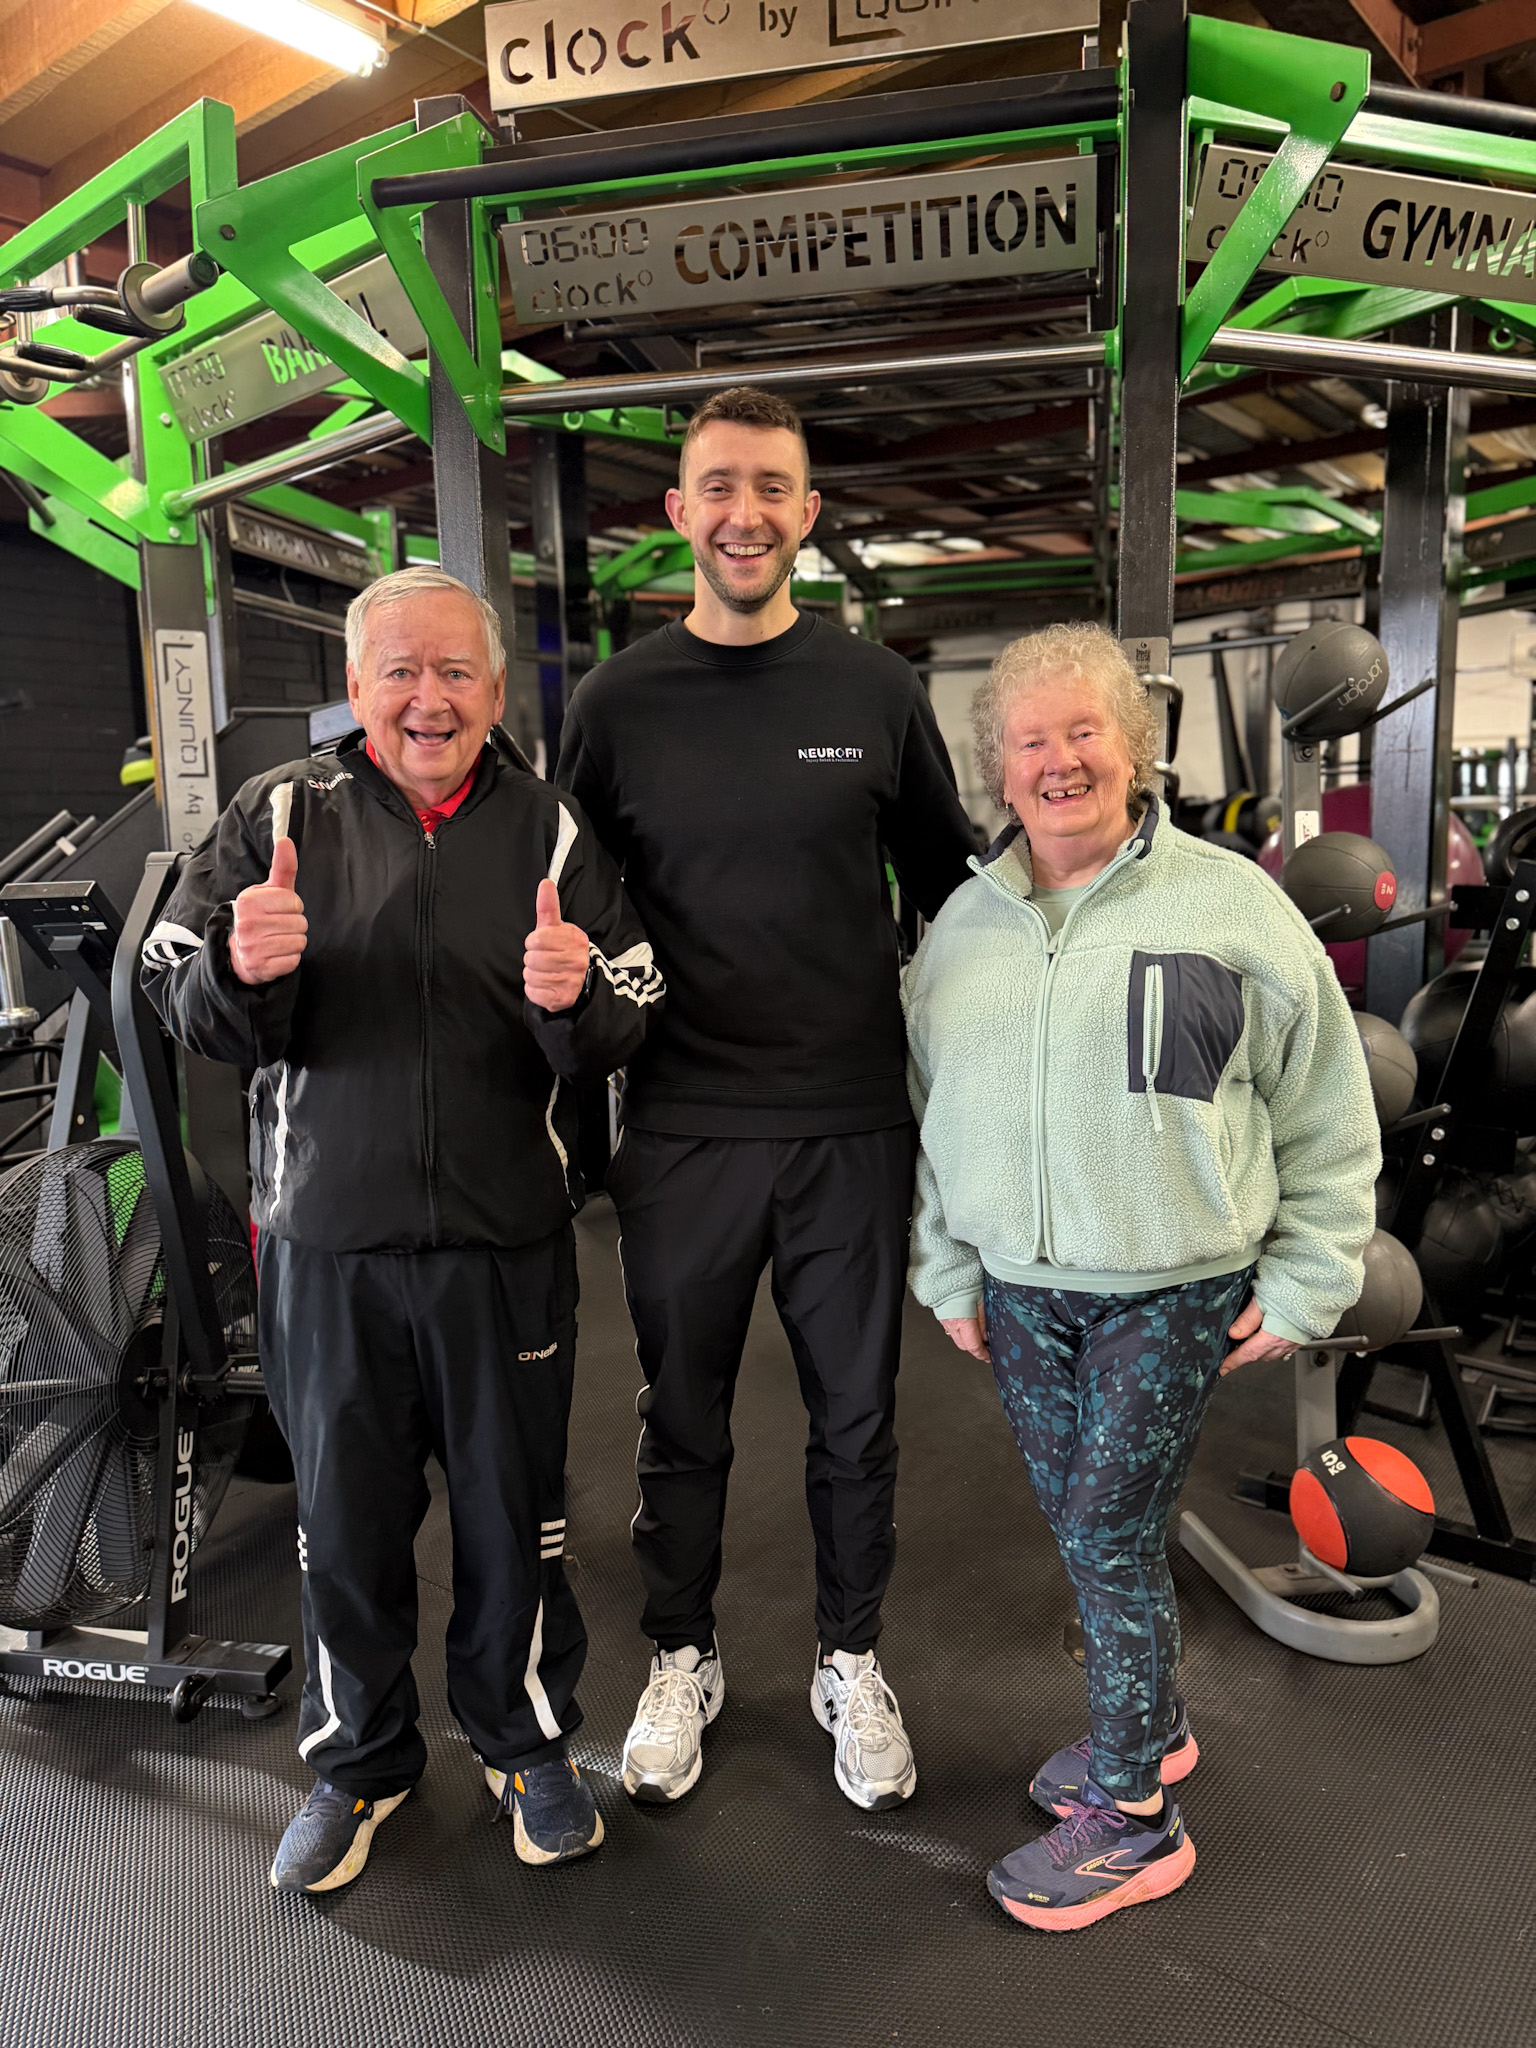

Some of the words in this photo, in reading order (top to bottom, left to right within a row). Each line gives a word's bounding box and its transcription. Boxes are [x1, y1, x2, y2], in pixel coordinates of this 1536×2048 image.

[759, 1, 797, 38] by
[521, 217, 649, 266] 06:00
[674, 183, 1077, 284] COMPETITION
[174, 658, 198, 764] QUINCY
[798, 747, 863, 759] NEUROFIT
[184, 792, 203, 815] by
[1321, 1449, 1339, 1467] 5
[1327, 1460, 1347, 1477] KG
